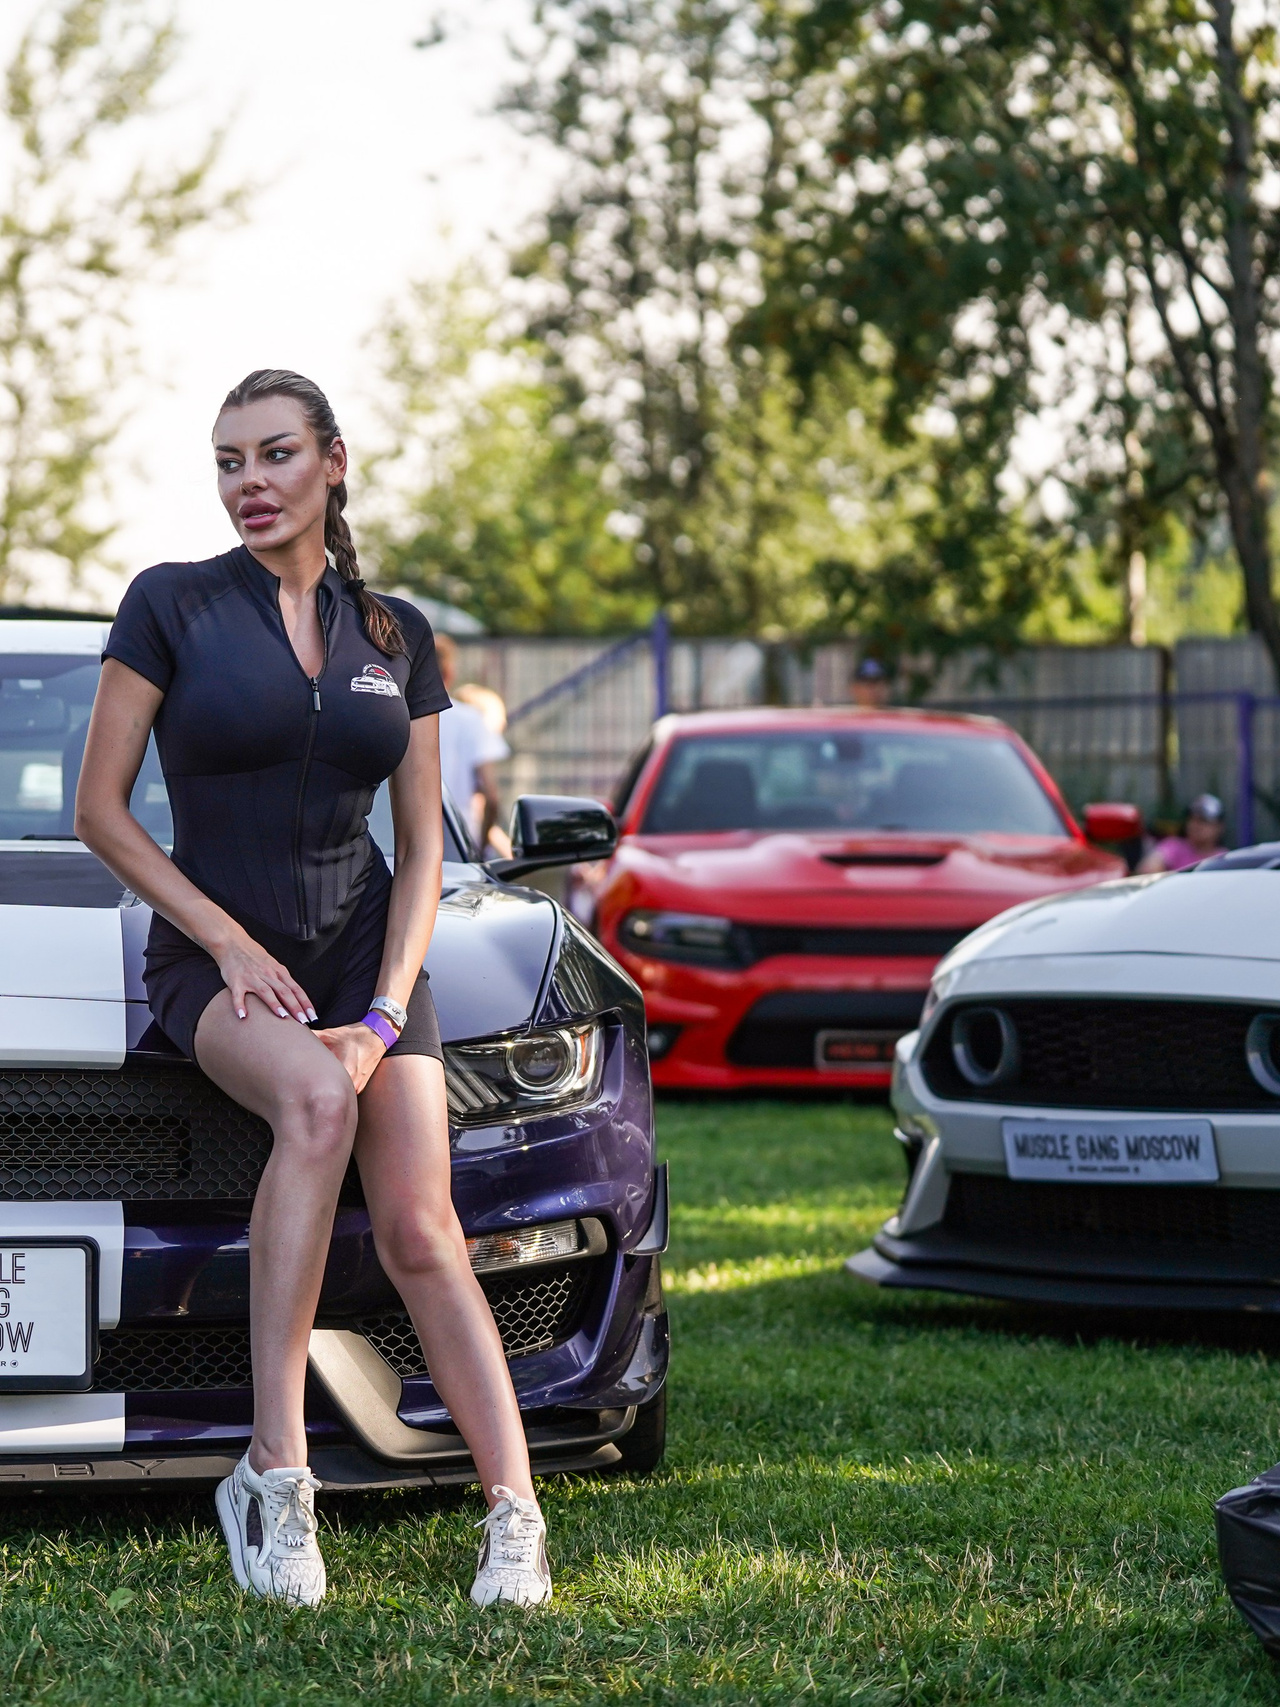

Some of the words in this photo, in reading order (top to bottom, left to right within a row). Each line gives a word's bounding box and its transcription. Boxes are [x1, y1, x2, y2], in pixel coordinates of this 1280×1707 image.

[1014, 1132, 1070, 1160] MUSCLE
[1076, 1133, 1120, 1160] GANG
[1124, 1133, 1200, 1161] MOSCOW
[287, 1534, 308, 1547] MK
